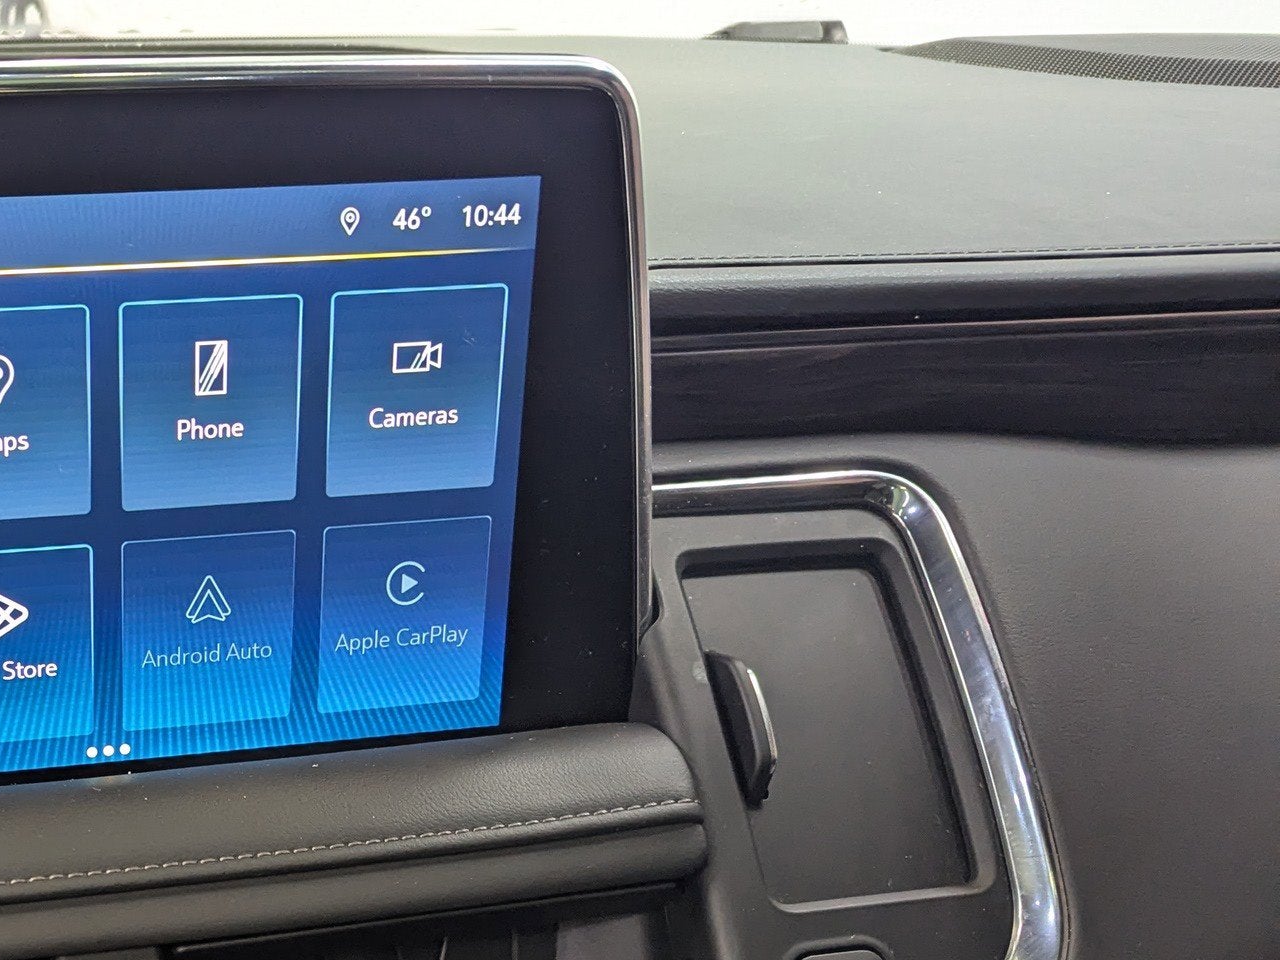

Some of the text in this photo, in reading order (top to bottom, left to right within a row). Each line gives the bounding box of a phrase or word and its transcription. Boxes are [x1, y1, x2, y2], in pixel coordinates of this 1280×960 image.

[462, 203, 522, 228] 10:44
[176, 417, 245, 442] Phone
[368, 406, 459, 430] Cameras
[334, 625, 469, 653] Apple CarPlay
[141, 642, 273, 669] Android Auto
[2, 660, 59, 681] Store
